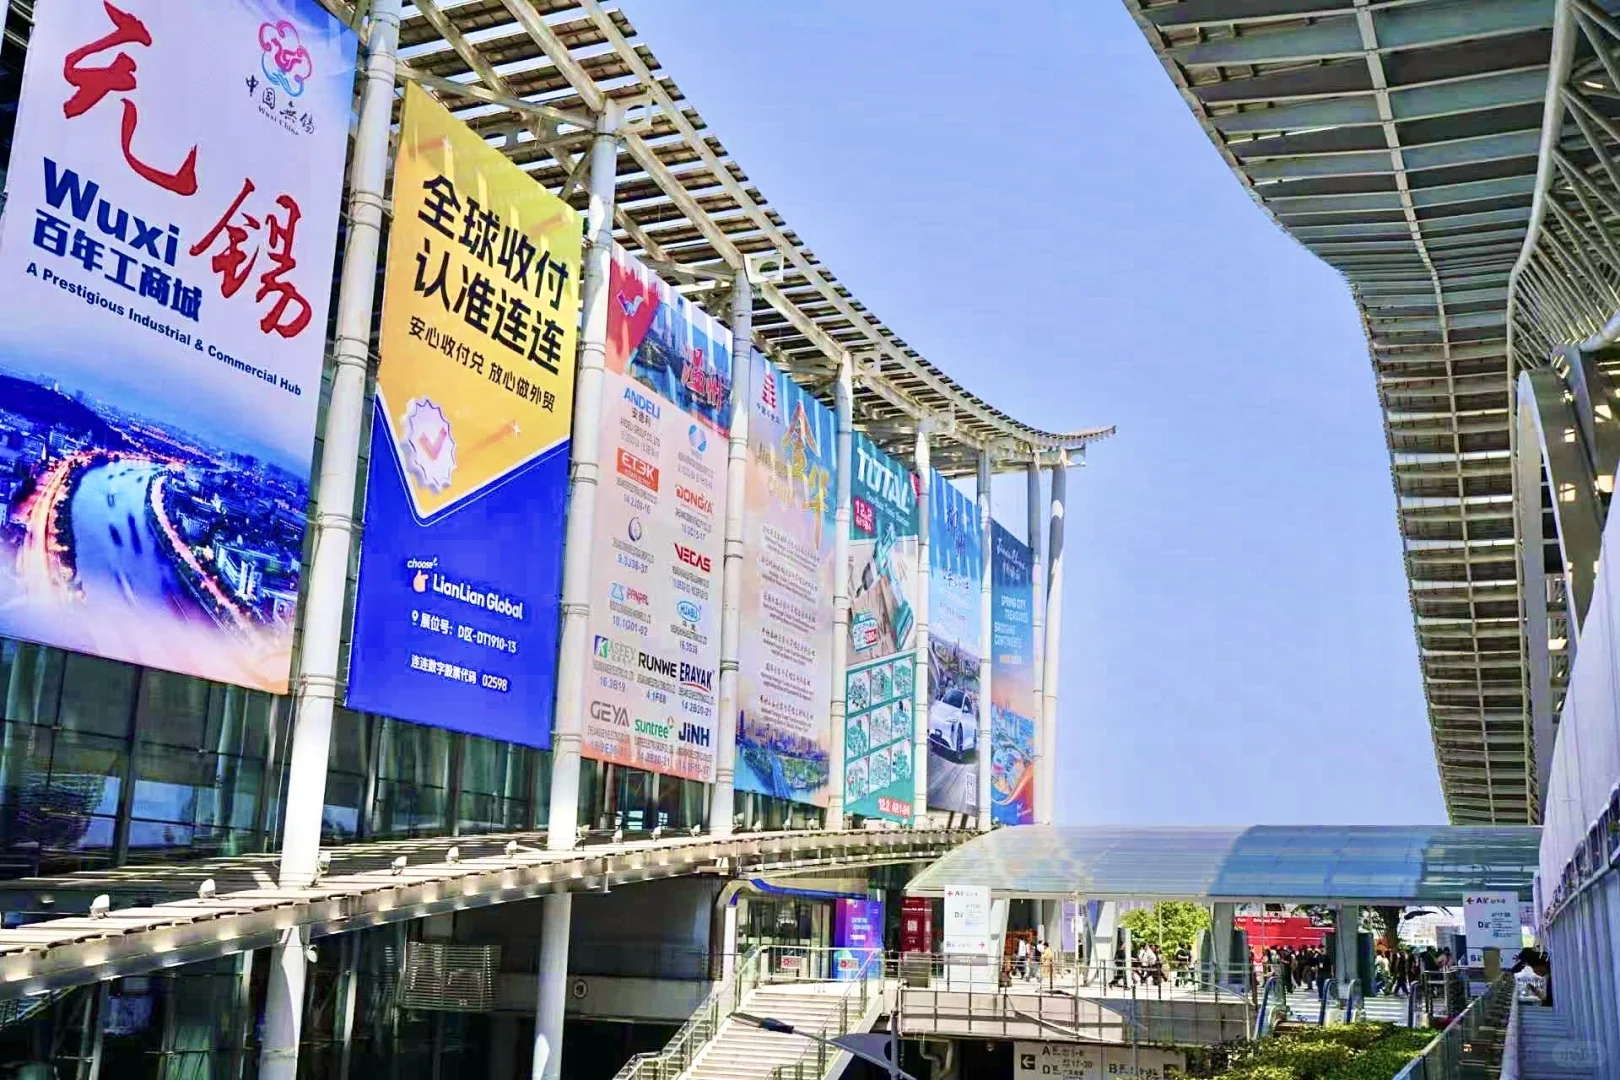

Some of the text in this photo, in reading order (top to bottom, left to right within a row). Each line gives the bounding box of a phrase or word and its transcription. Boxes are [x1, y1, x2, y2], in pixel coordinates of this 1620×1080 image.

[43, 156, 180, 267] Wuxi
[32, 208, 203, 322] 百年工商城
[417, 174, 568, 311] 全球收付
[26, 262, 302, 397] A Prestigious Industrial & Commercial Hub
[413, 238, 565, 375] 认准连连
[408, 315, 556, 413] 安心收付兑 放心做外贸
[624, 387, 660, 420] ANDELI
[857, 447, 910, 515] TOTAL
[407, 557, 434, 569] choose
[432, 573, 524, 620] LianLian Global
[481, 674, 508, 692] 02598
[638, 652, 677, 678] RUNWE
[680, 661, 712, 692] ERAYAK
[590, 700, 629, 728] GEYA
[634, 718, 669, 739] suntree
